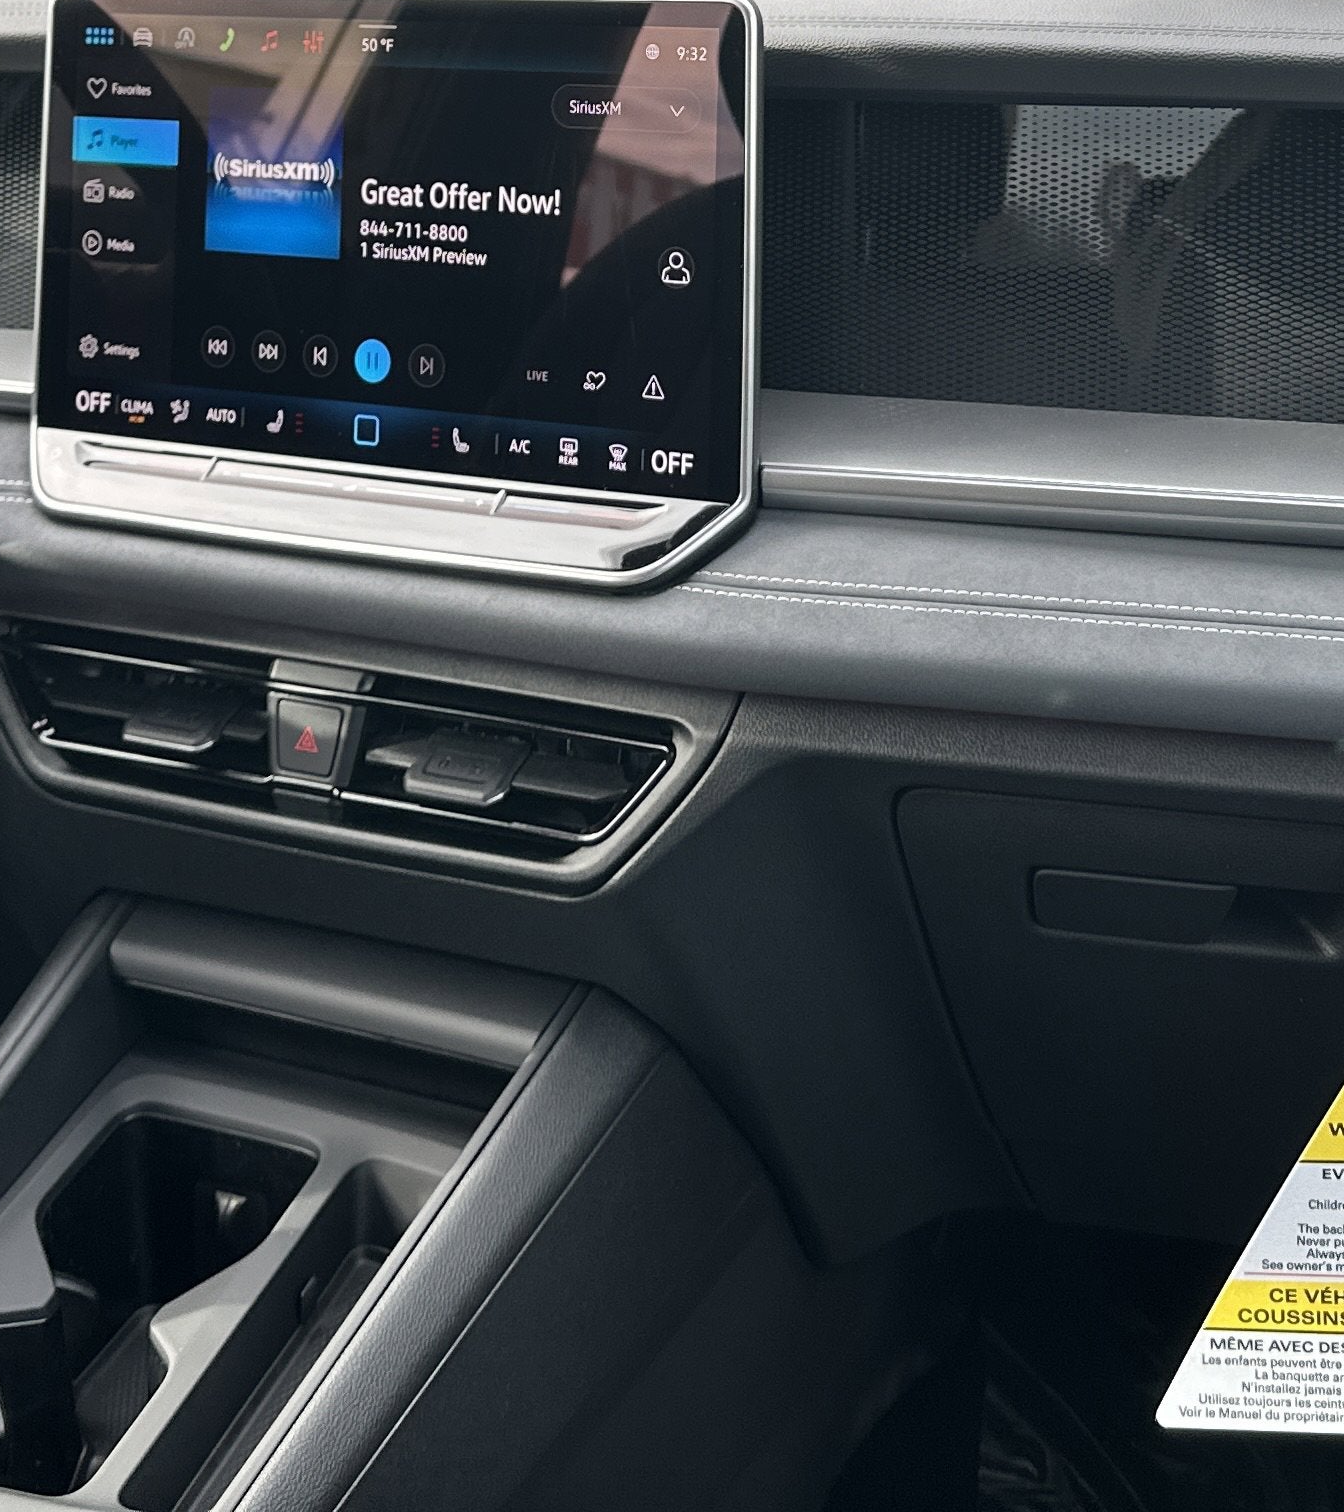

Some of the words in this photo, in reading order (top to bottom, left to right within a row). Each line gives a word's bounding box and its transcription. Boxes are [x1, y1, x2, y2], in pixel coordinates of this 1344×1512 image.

[361, 38, 378, 52] 50
[676, 46, 708, 62] 9:32
[111, 83, 152, 97] Favorites
[569, 99, 622, 116] SiriusXM
[108, 187, 135, 200] Radio
[360, 177, 424, 208] Great
[429, 182, 492, 212] Offer
[498, 186, 562, 216] Now!
[359, 219, 468, 243] 844-711-8800
[107, 238, 135, 253] Media
[360, 242, 368, 258] 1
[372, 243, 429, 264] SiriusXM
[433, 247, 488, 267] Preview
[103, 342, 140, 360] Settings
[526, 370, 548, 382] LIVE
[75, 389, 111, 414] OFF
[120, 398, 154, 415] CLIMA
[206, 408, 236, 424] AUTO
[509, 439, 531, 454] A/C
[650, 449, 694, 476] OFF
[1297, 1223, 1320, 1235] The
[1296, 1235, 1330, 1247] Never
[1261, 1258, 1283, 1270] See
[1285, 1259, 1332, 1272] owner's
[1268, 1288, 1297, 1304] CE
[1209, 1335, 1263, 1352] MÊME
[1268, 1340, 1313, 1354] AVEC
